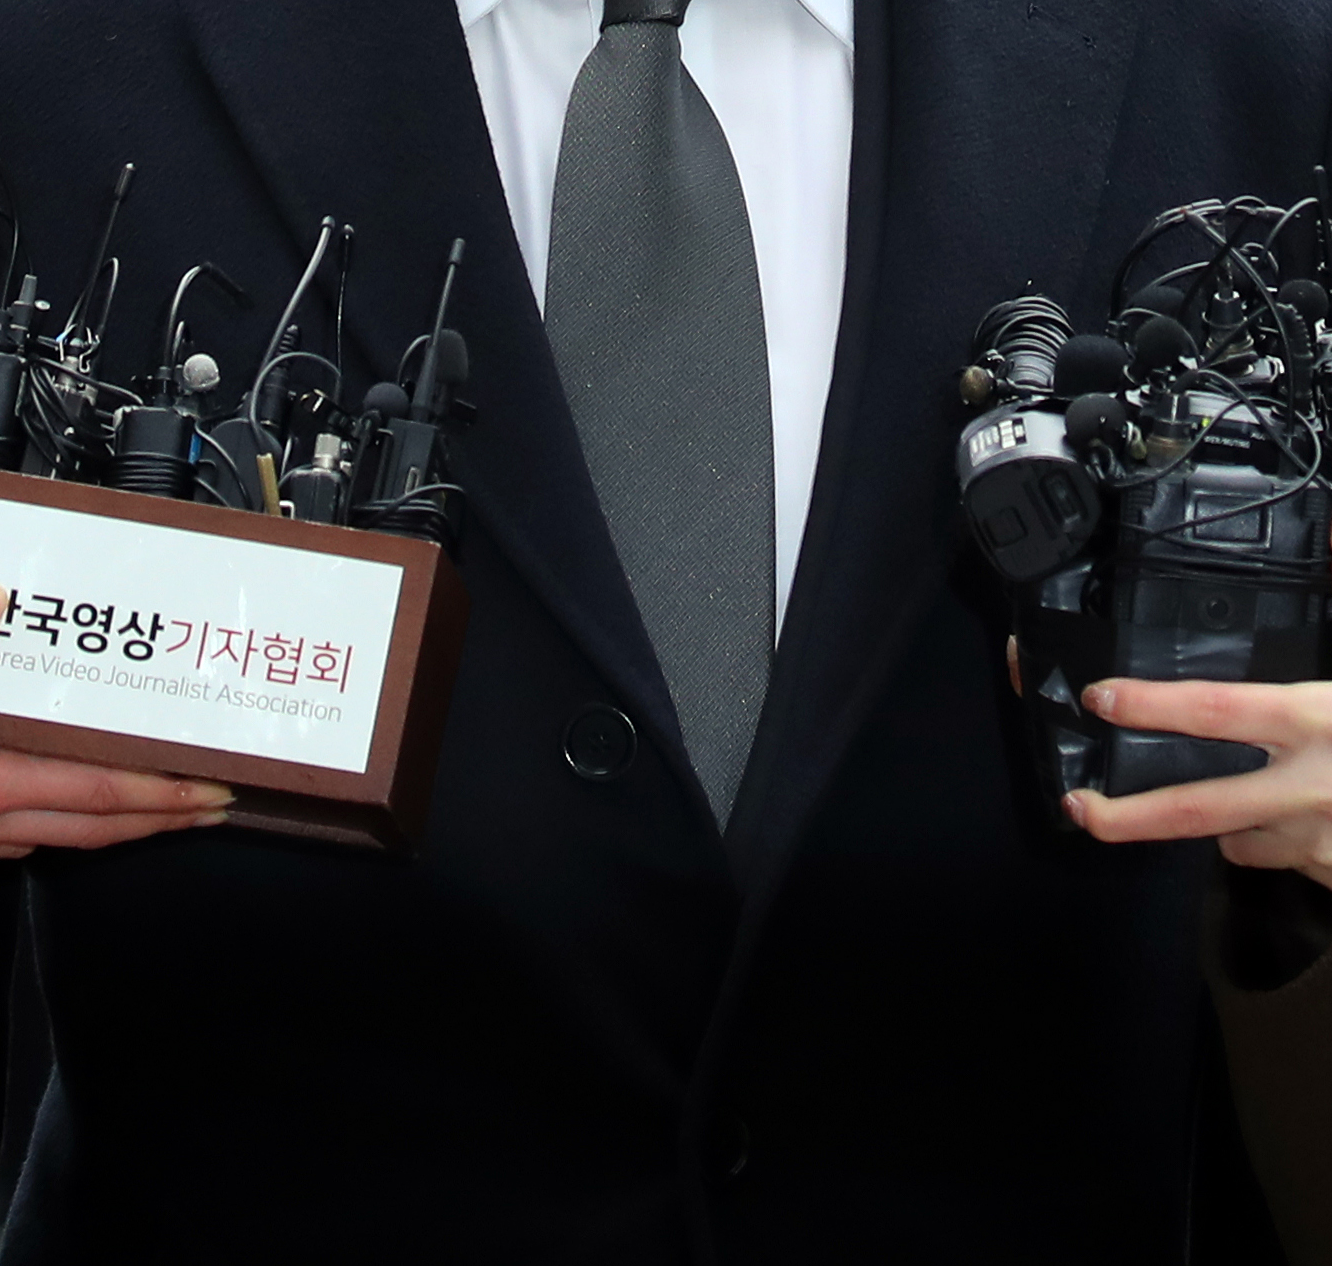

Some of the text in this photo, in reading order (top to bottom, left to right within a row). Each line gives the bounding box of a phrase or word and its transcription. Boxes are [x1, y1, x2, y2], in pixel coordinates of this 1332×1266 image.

[40, 652, 101, 682] Video
[103, 665, 211, 702] Journalist
[215, 683, 342, 723] Association
